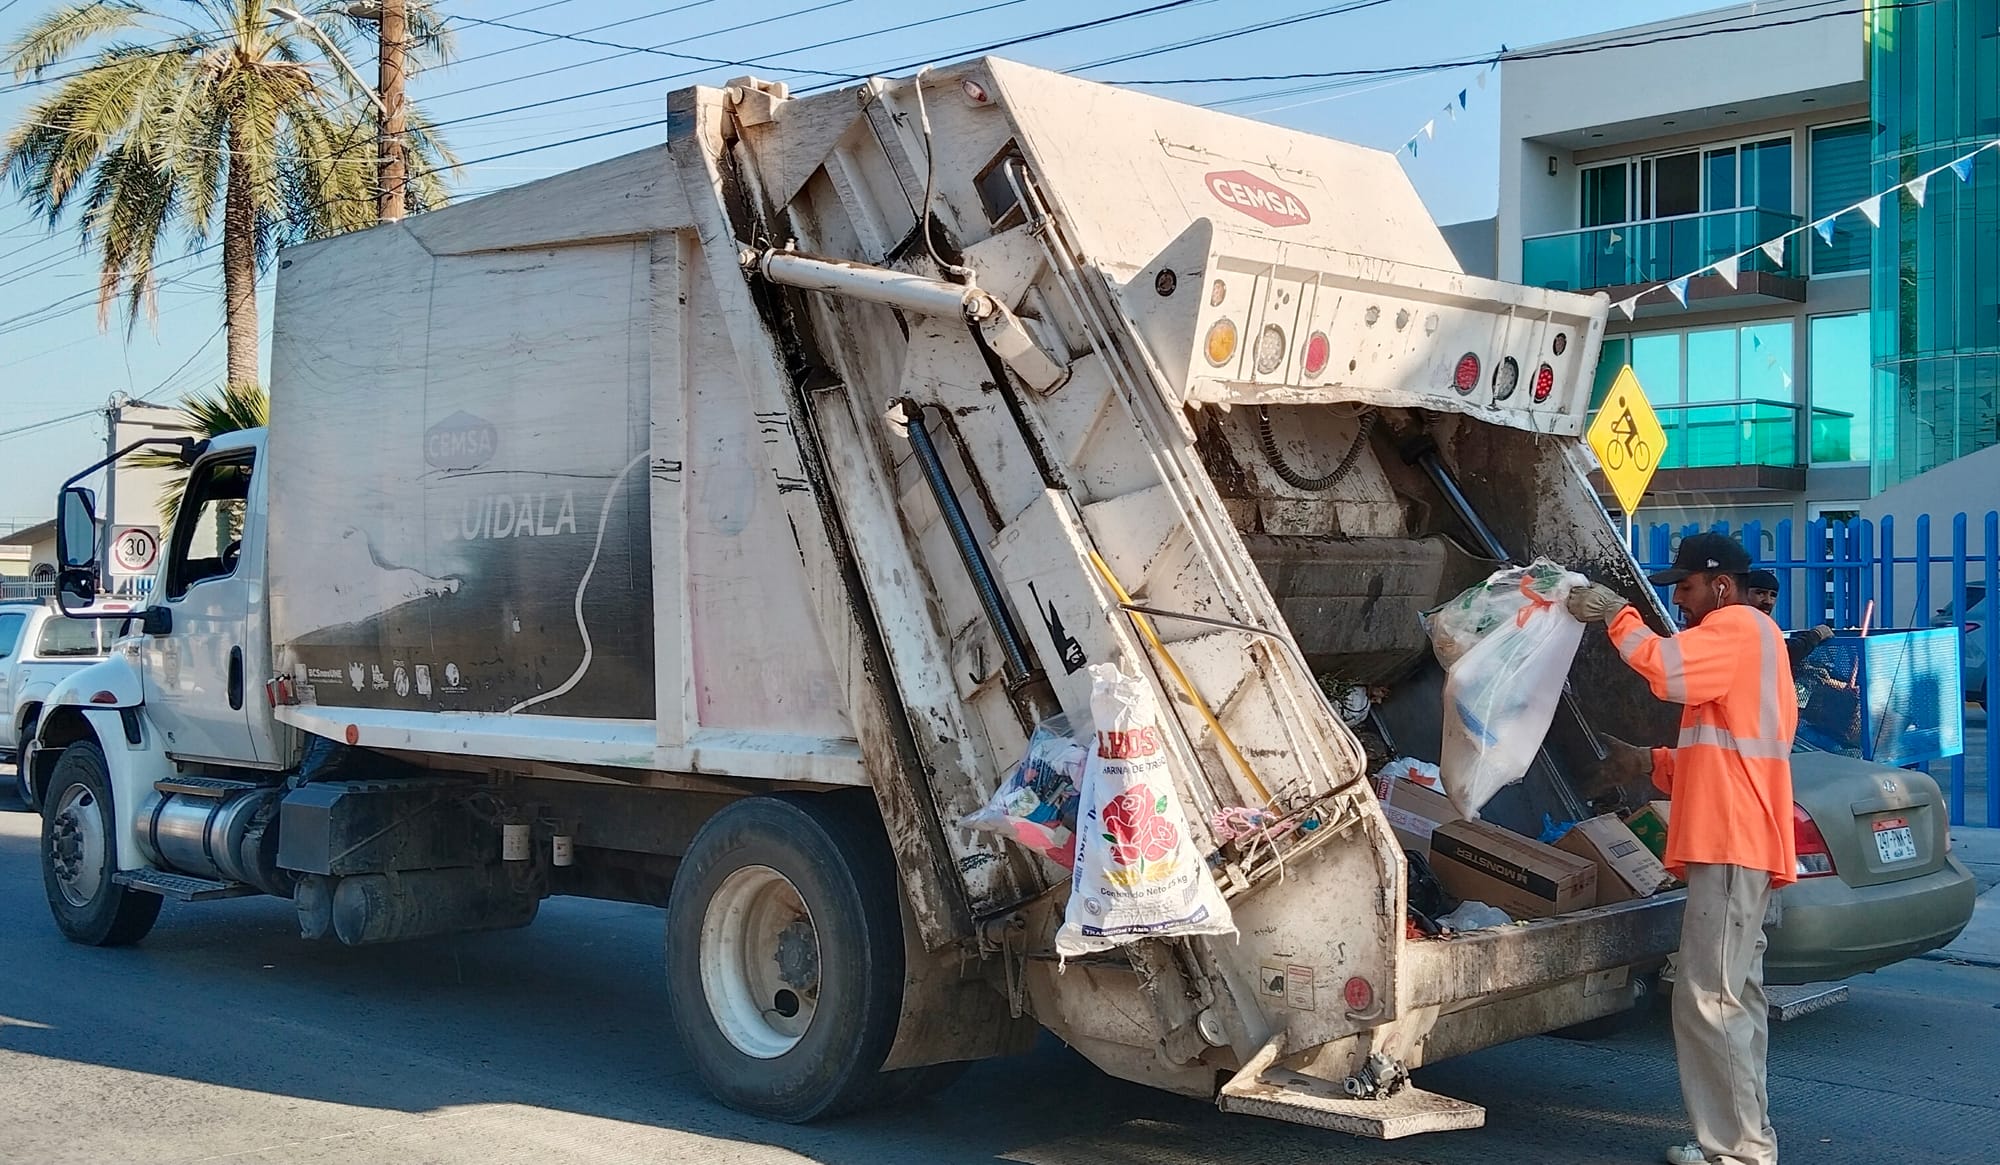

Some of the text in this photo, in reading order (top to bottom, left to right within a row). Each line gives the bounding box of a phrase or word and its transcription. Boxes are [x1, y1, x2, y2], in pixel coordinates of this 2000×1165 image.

[1212, 178, 1308, 220] CEMSA
[429, 429, 491, 458] CEMSA
[441, 489, 577, 541] CUIDALA
[125, 538, 146, 556] 30
[1132, 763, 1145, 774] DE
[1456, 847, 1516, 880] MONSTER
[1146, 886, 1167, 897] Neto
[1177, 874, 1188, 885] kg
